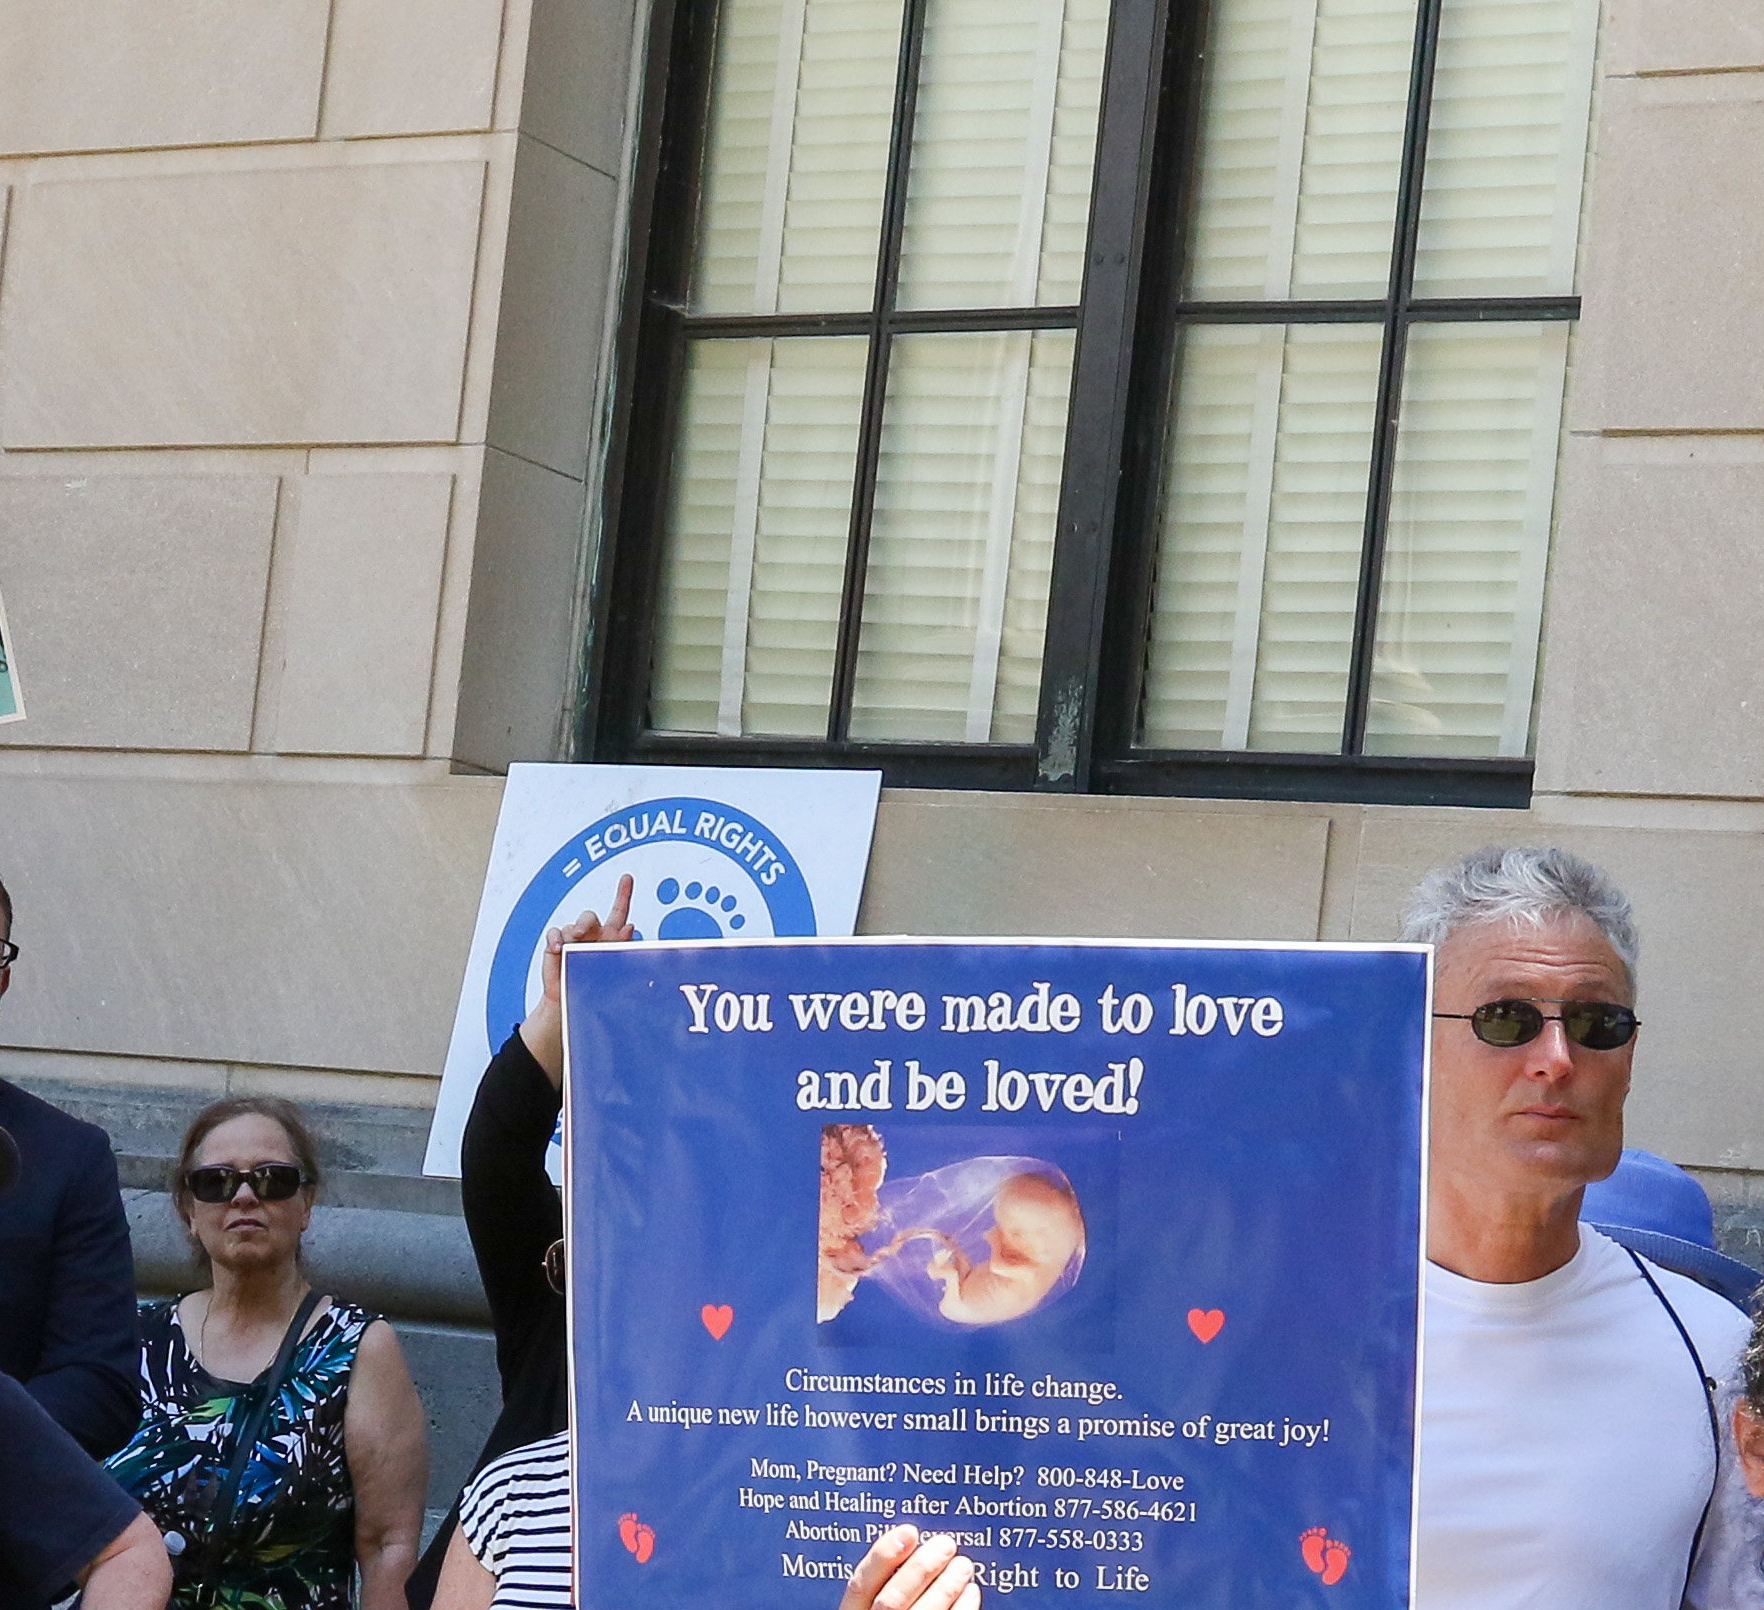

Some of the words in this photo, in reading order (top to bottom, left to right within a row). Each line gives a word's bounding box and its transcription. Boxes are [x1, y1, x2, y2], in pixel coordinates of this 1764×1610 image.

[584, 809, 687, 862] EQUAL
[694, 811, 786, 887] RIGHTS
[679, 983, 774, 1034] You
[788, 989, 926, 1031] were
[940, 981, 1081, 1033] made
[1097, 984, 1154, 1034] to
[1168, 983, 1284, 1037] love
[796, 1059, 893, 1111] and
[904, 1060, 966, 1111] be
[981, 1057, 1144, 1115] loved!
[785, 1367, 946, 1395] Circumstances
[954, 1371, 977, 1396] in
[985, 1372, 1025, 1397] life
[1031, 1374, 1123, 1405] change.
[626, 1399, 644, 1422] A
[647, 1400, 713, 1430] unique
[717, 1408, 761, 1425] new
[765, 1402, 799, 1427] life
[804, 1404, 898, 1430] however
[903, 1407, 967, 1432] small
[975, 1408, 1050, 1440] brings
[1057, 1417, 1071, 1434] a
[1077, 1413, 1175, 1441] promise
[1182, 1414, 1212, 1439] of
[1214, 1420, 1276, 1445] great
[1278, 1417, 1329, 1447] joy!
[750, 1457, 802, 1483] Mom,
[806, 1459, 897, 1486] Pregnant?
[902, 1463, 957, 1484] Need
[963, 1464, 1025, 1491] Help?
[1037, 1466, 1185, 1491] 800-848-Love
[739, 1487, 785, 1514] Hope
[789, 1490, 821, 1510] and
[824, 1491, 896, 1519] Healing
[901, 1493, 950, 1515] after
[954, 1495, 1048, 1518] Abortion
[1054, 1498, 1196, 1522] 877-586-4621
[785, 1519, 862, 1543] Abortion
[999, 1527, 1143, 1552] 877-558-0333
[1054, 1567, 1080, 1589] to
[1095, 1565, 1150, 1592] Life
